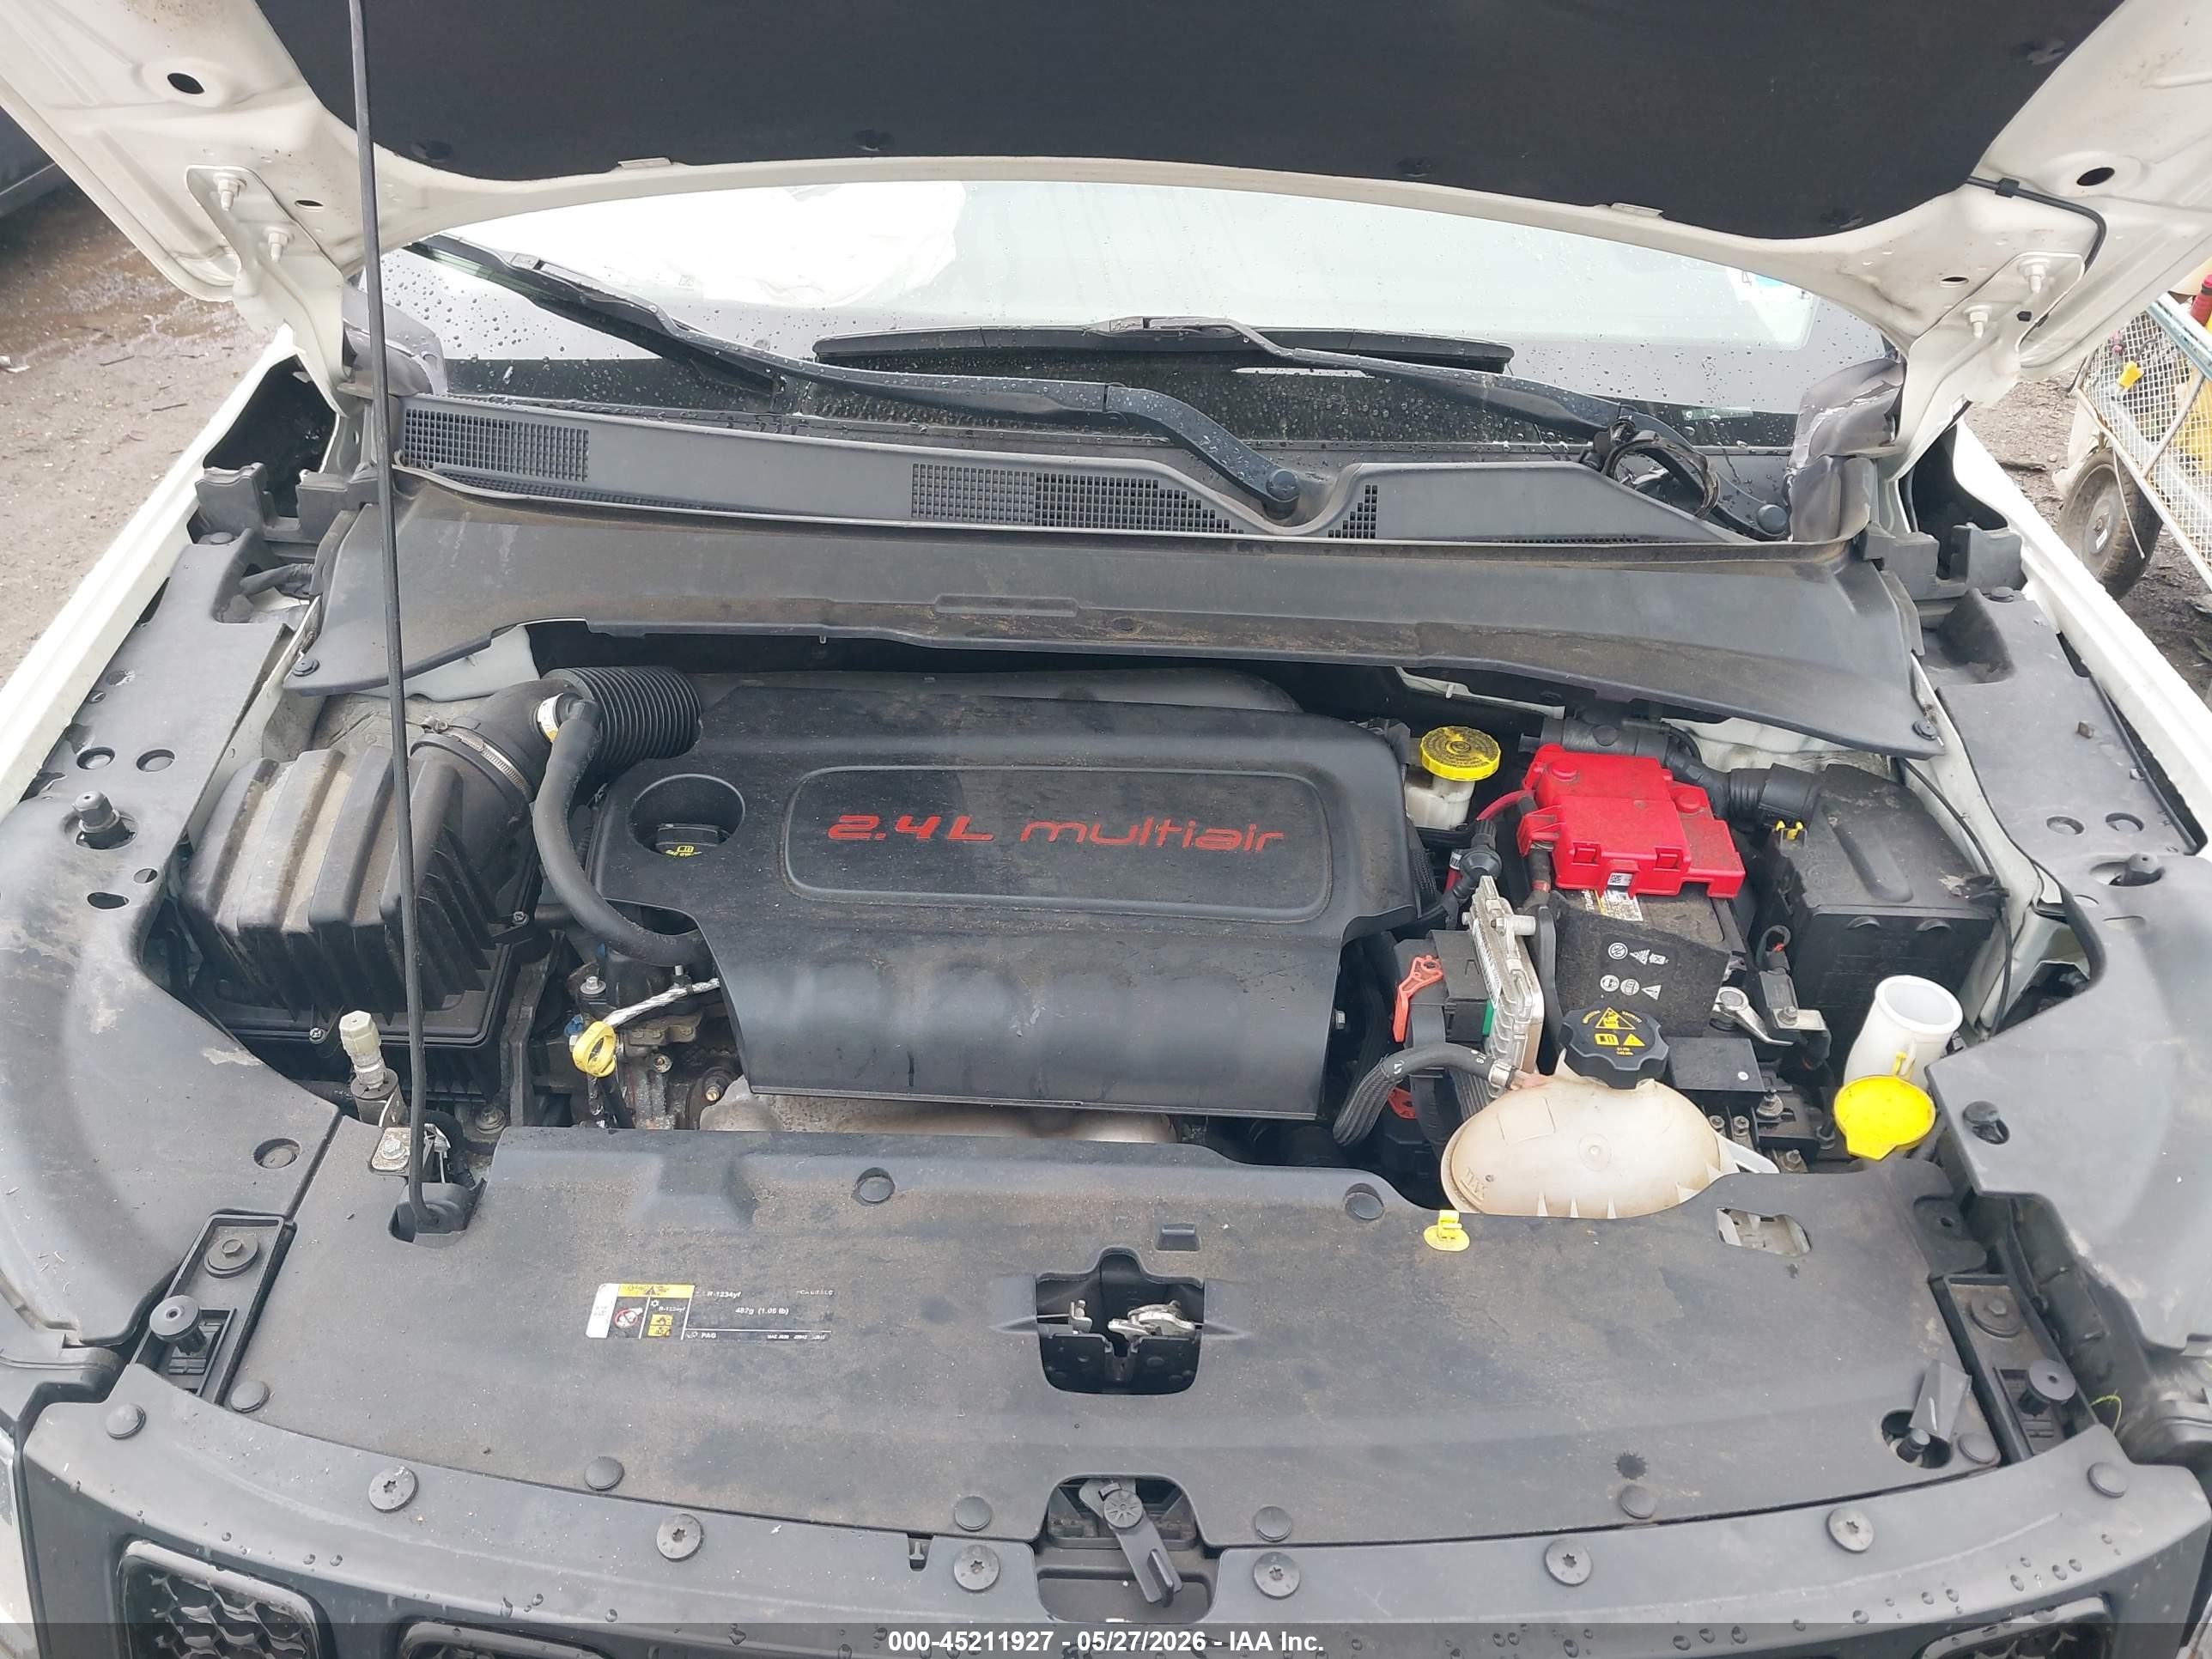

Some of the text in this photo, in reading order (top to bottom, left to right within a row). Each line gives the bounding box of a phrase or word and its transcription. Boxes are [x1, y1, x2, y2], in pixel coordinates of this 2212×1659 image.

[827, 814, 1285, 852] 2.4L multiair
[707, 1291, 742, 1299] R-1234yf
